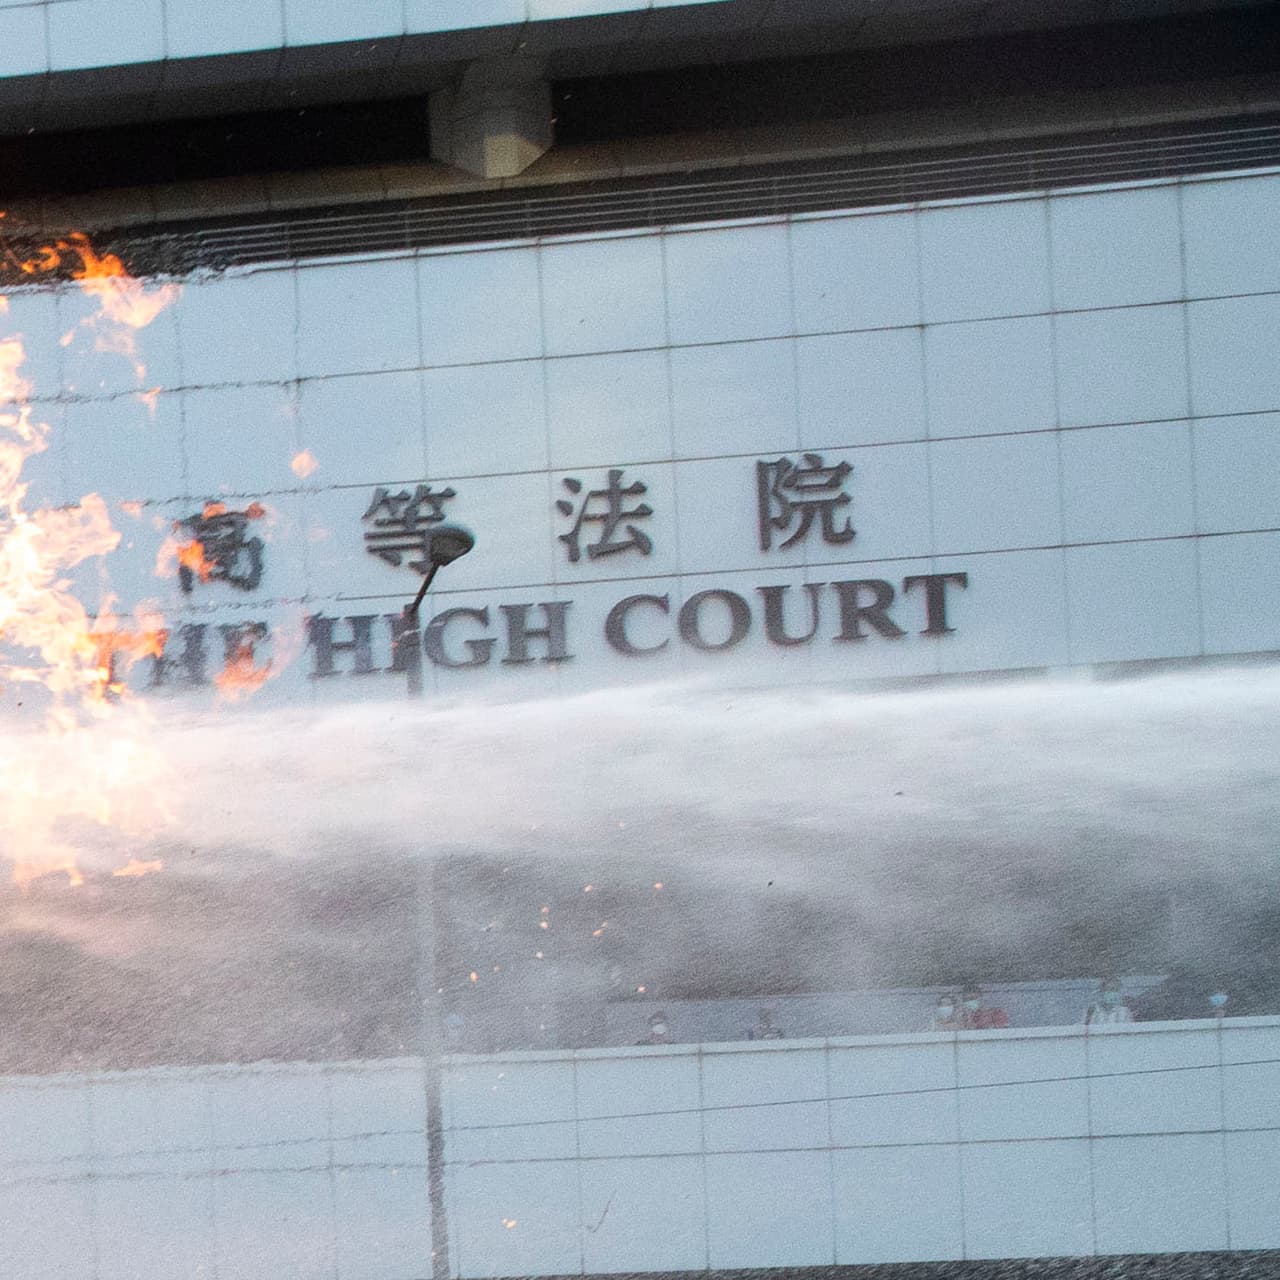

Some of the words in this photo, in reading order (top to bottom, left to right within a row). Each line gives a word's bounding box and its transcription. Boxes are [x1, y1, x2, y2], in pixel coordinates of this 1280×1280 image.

[172, 453, 858, 593] 高等法院
[304, 598, 576, 679] HIGH
[603, 571, 970, 658] COURT
